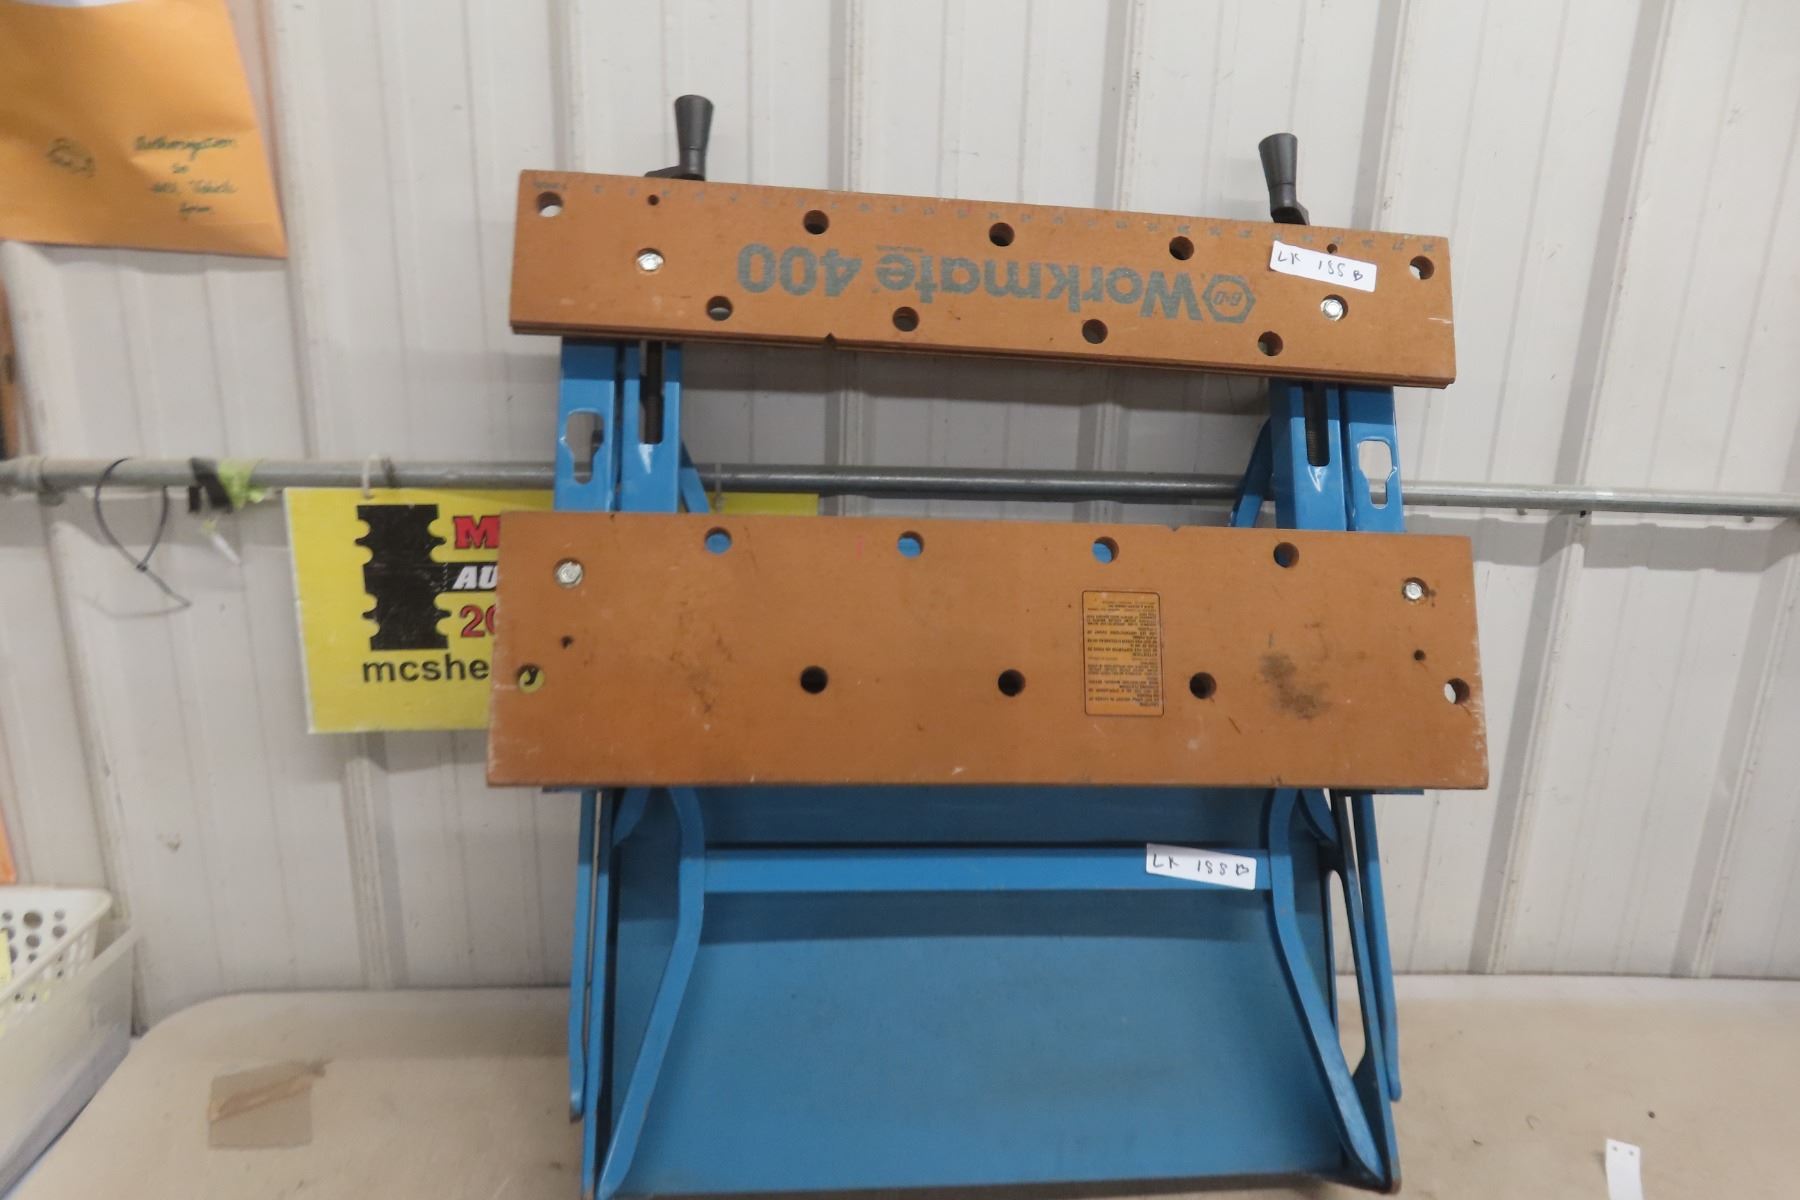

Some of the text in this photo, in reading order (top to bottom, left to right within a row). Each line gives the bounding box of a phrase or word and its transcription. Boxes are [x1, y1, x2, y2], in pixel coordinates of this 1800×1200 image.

[736, 242, 863, 297] 400
[874, 250, 1203, 321] Workmate
[362, 654, 489, 683] mcshe
